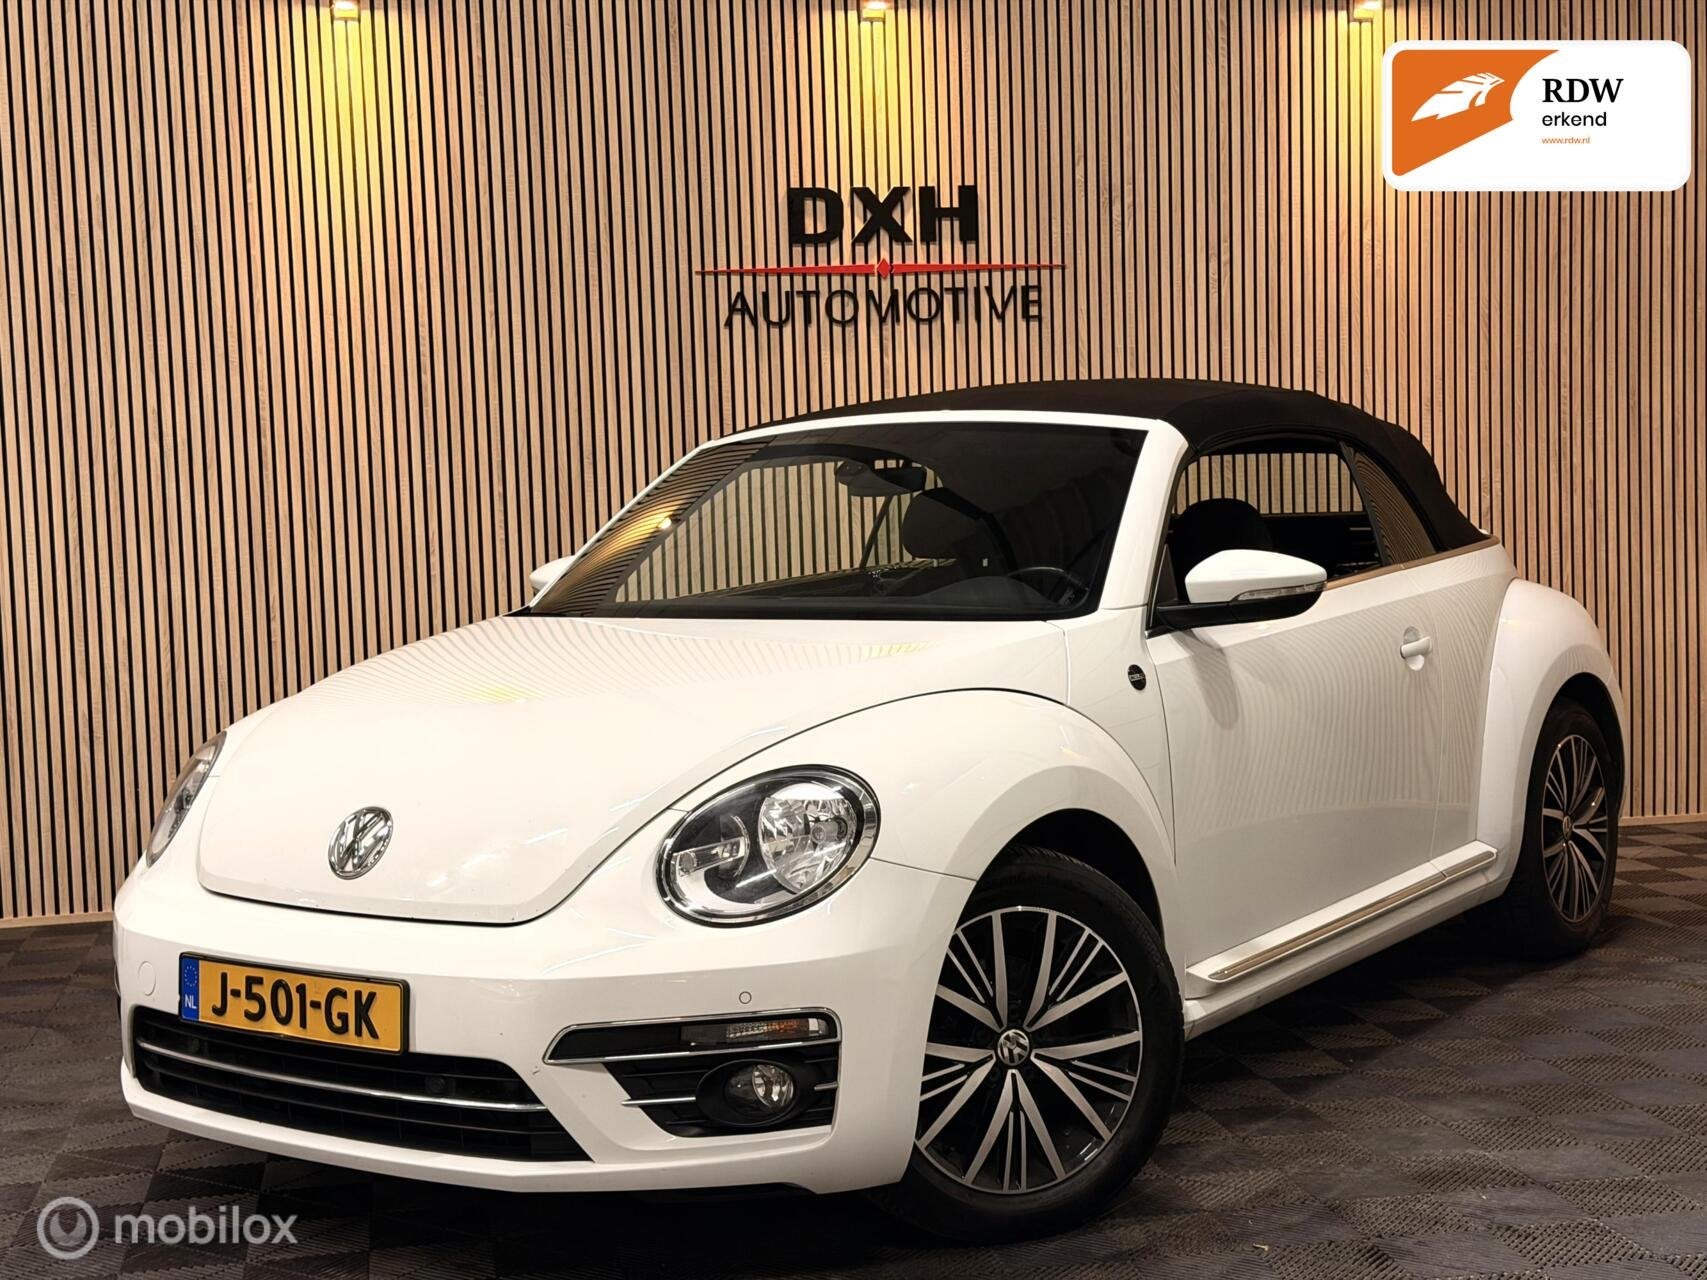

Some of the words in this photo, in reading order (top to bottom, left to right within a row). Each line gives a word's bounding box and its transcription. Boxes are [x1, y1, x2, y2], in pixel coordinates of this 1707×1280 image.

[786, 184, 980, 245] DXH
[723, 284, 1043, 330] AUTOMOTIVE
[184, 994, 198, 1010] NL
[211, 971, 380, 1040] J-501-GK
